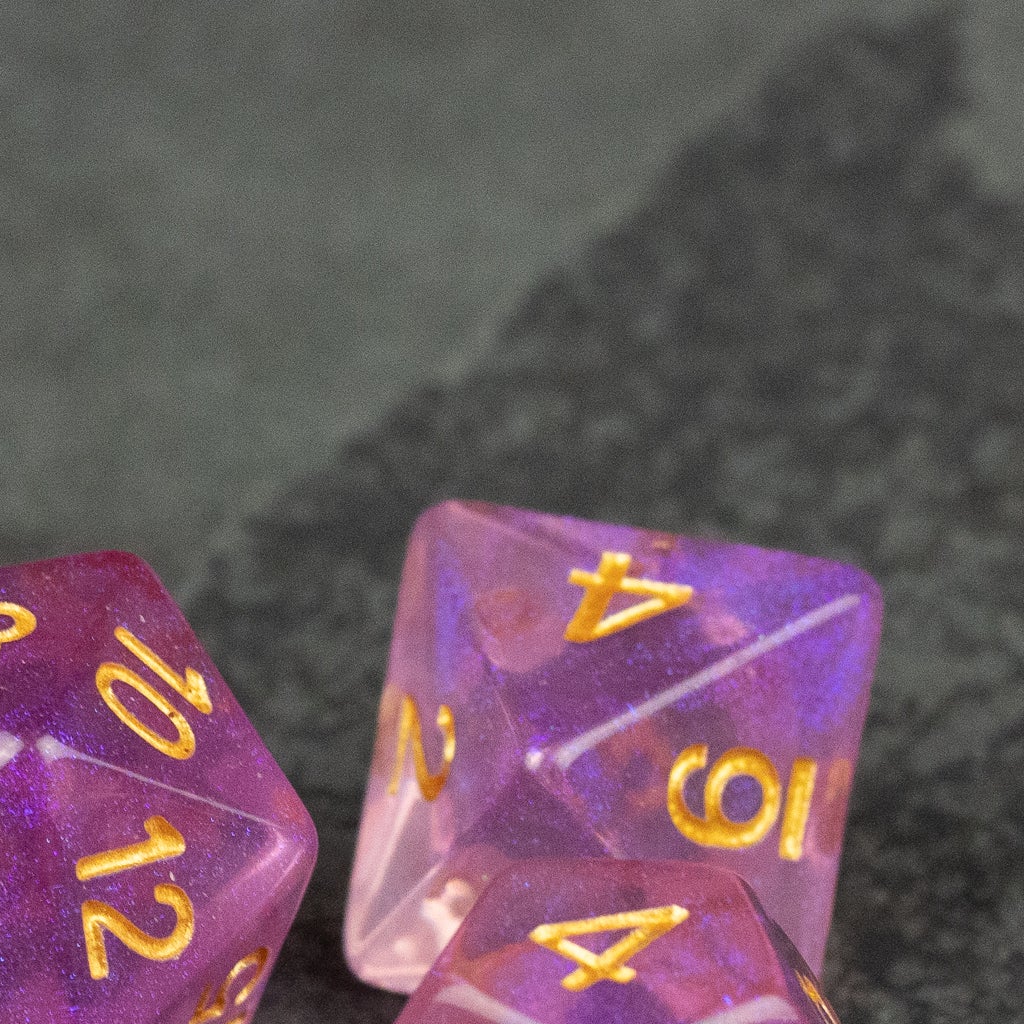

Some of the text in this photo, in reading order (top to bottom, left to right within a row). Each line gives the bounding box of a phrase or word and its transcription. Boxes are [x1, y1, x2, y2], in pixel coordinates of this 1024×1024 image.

[564, 552, 694, 643] 4
[95, 627, 212, 760] 10
[387, 694, 456, 802] 2
[667, 744, 816, 861] 6
[76, 815, 195, 981] 12
[529, 904, 690, 992] 4
